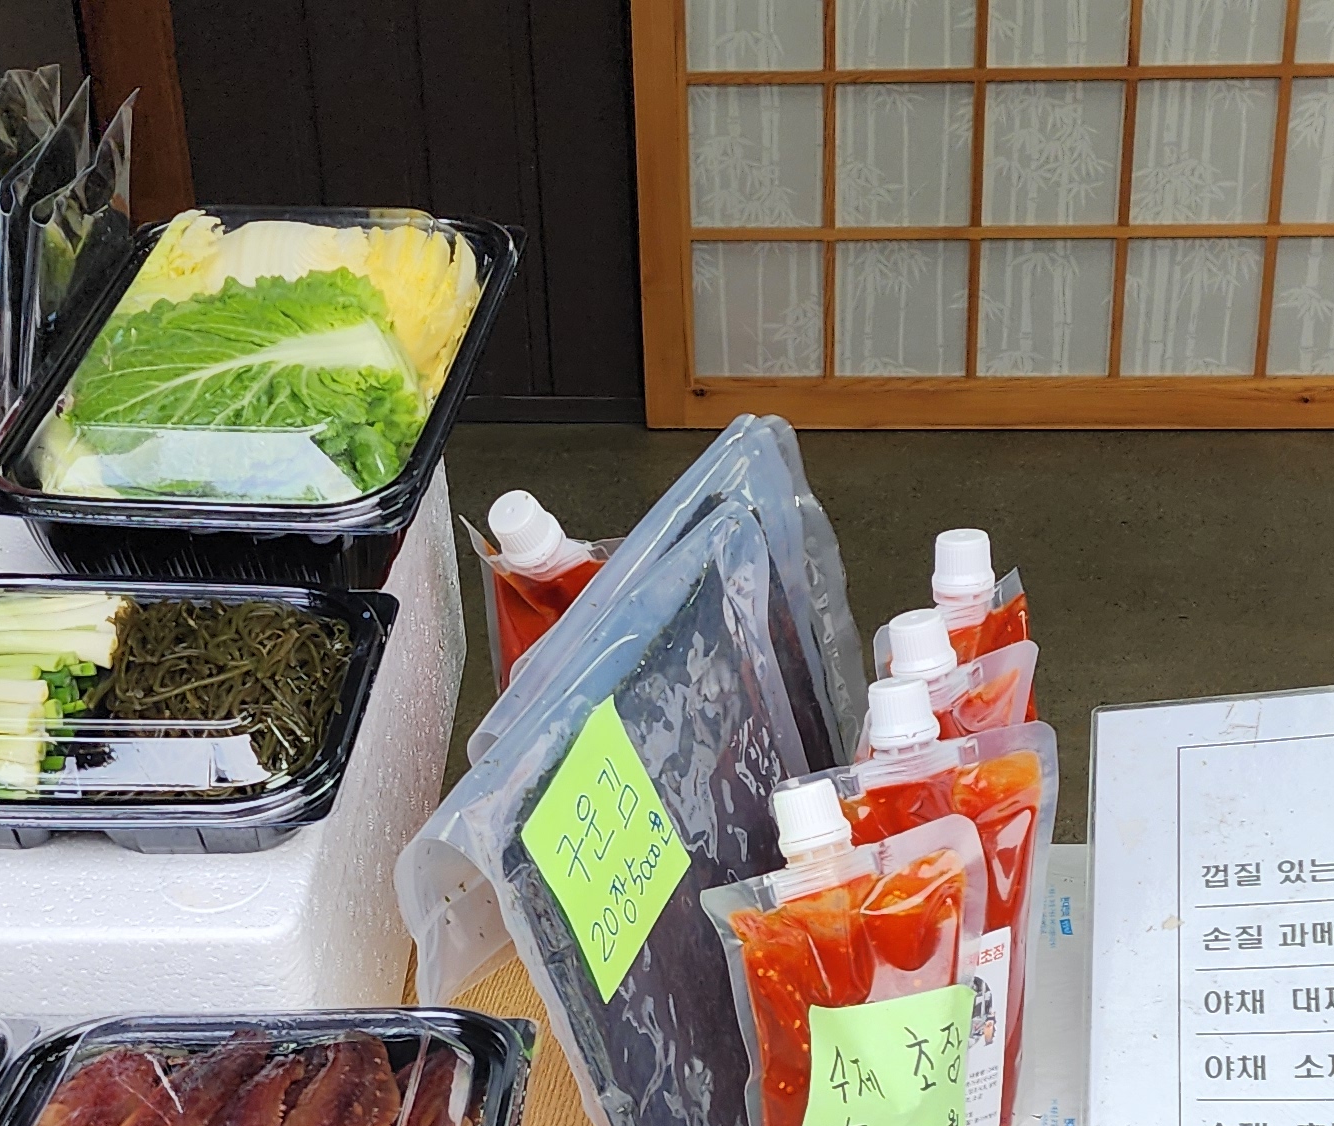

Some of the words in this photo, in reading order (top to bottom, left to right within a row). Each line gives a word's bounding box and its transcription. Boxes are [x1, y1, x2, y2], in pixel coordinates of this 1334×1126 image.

[556, 794, 615, 882] 구운
[597, 757, 639, 830] 김
[1201, 862, 1262, 888] 껍질
[1202, 924, 1264, 951] 손질
[1204, 988, 1265, 1015] 야채
[829, 1045, 886, 1104] 수제
[903, 1021, 963, 1092] 초장
[1204, 1054, 1266, 1081] 야채
